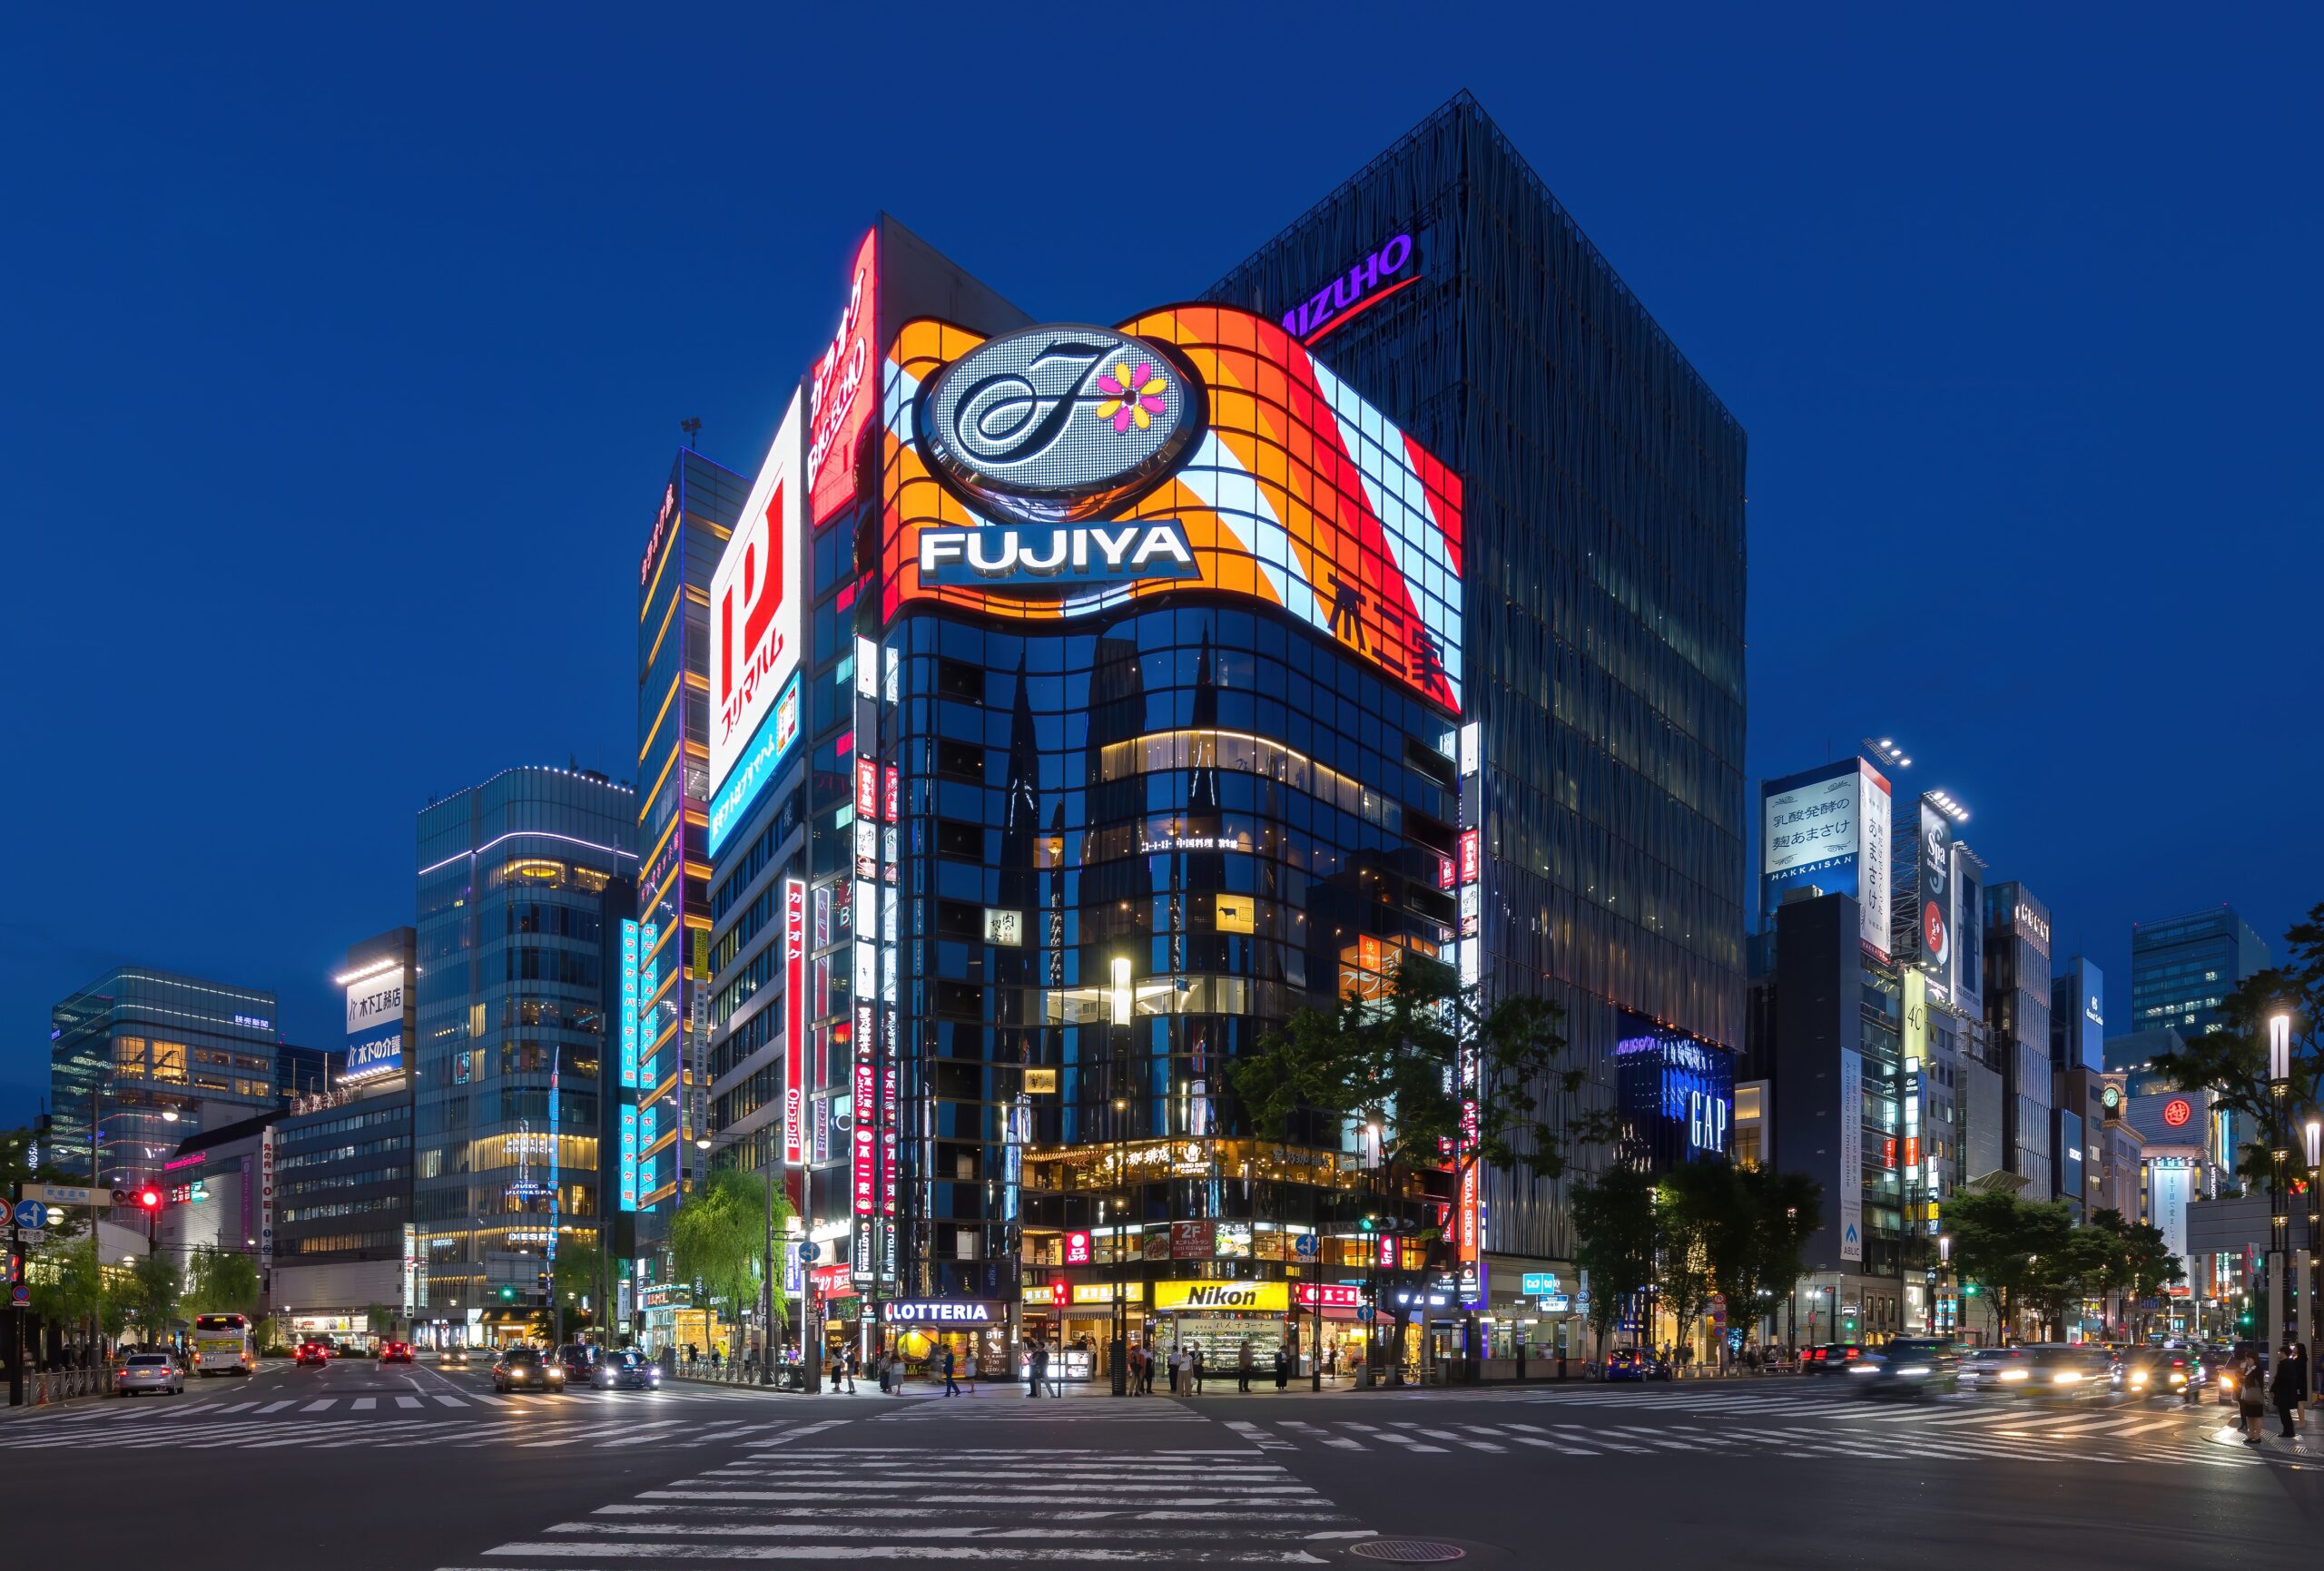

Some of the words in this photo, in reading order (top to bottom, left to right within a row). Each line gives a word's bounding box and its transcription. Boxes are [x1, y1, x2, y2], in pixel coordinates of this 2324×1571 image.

[811, 269, 864, 428] カラオケ
[808, 417, 830, 494] BIG
[831, 337, 865, 433] ECHO
[921, 525, 1191, 574] FUJIYA
[1328, 573, 1444, 700] 不二家
[722, 627, 783, 745] プリマハム
[1773, 799, 1850, 828] 乳酸発酵の
[1177, 837, 1214, 849] 中国料理
[1773, 820, 1850, 850] 麹あまさけ
[1928, 831, 1946, 864] Spa
[1772, 856, 1852, 880] HAKKAISAN
[1868, 818, 1877, 909] あまさけ
[1926, 859, 1947, 878] treatment
[789, 892, 802, 959] カラオケ
[991, 919, 1001, 943] 切り方
[1002, 912, 1014, 931] 肉の
[2022, 903, 2049, 943] GUCCI
[359, 987, 401, 1017] 木下工務店
[625, 924, 635, 1080] カラオケ&パーティー館
[234, 1015, 269, 1028] 読売新聞
[358, 1035, 401, 1065] 木下の介護
[788, 1088, 800, 1124] ECHO
[864, 1076, 873, 1109] 不二家
[787, 1125, 800, 1148] BIG
[1692, 1090, 1726, 1153] GAP
[263, 1143, 271, 1168] 丸の内
[624, 1115, 634, 1201] カラオケ館
[859, 1145, 871, 1195] 不二家
[263, 1173, 272, 1222] TOEI
[1464, 1168, 1473, 1207] REGAL
[508, 1233, 556, 1242] DIESEL
[1181, 1223, 1201, 1239] 2F
[1218, 1224, 1231, 1233] 2F
[1464, 1209, 1473, 1247] SHOES
[862, 1232, 870, 1272] LOTTERIA
[1844, 1246, 1859, 1256] ABLIC
[833, 1274, 842, 1291] BIG
[1187, 1287, 1256, 1305] Nikon
[1324, 1290, 1355, 1302] 不二家
[893, 1304, 988, 1320] LOTTERIA
[1216, 1321, 1271, 1330] れんずコーナー
[969, 1340, 979, 1349] 45
[986, 1330, 1005, 1340] B1F
